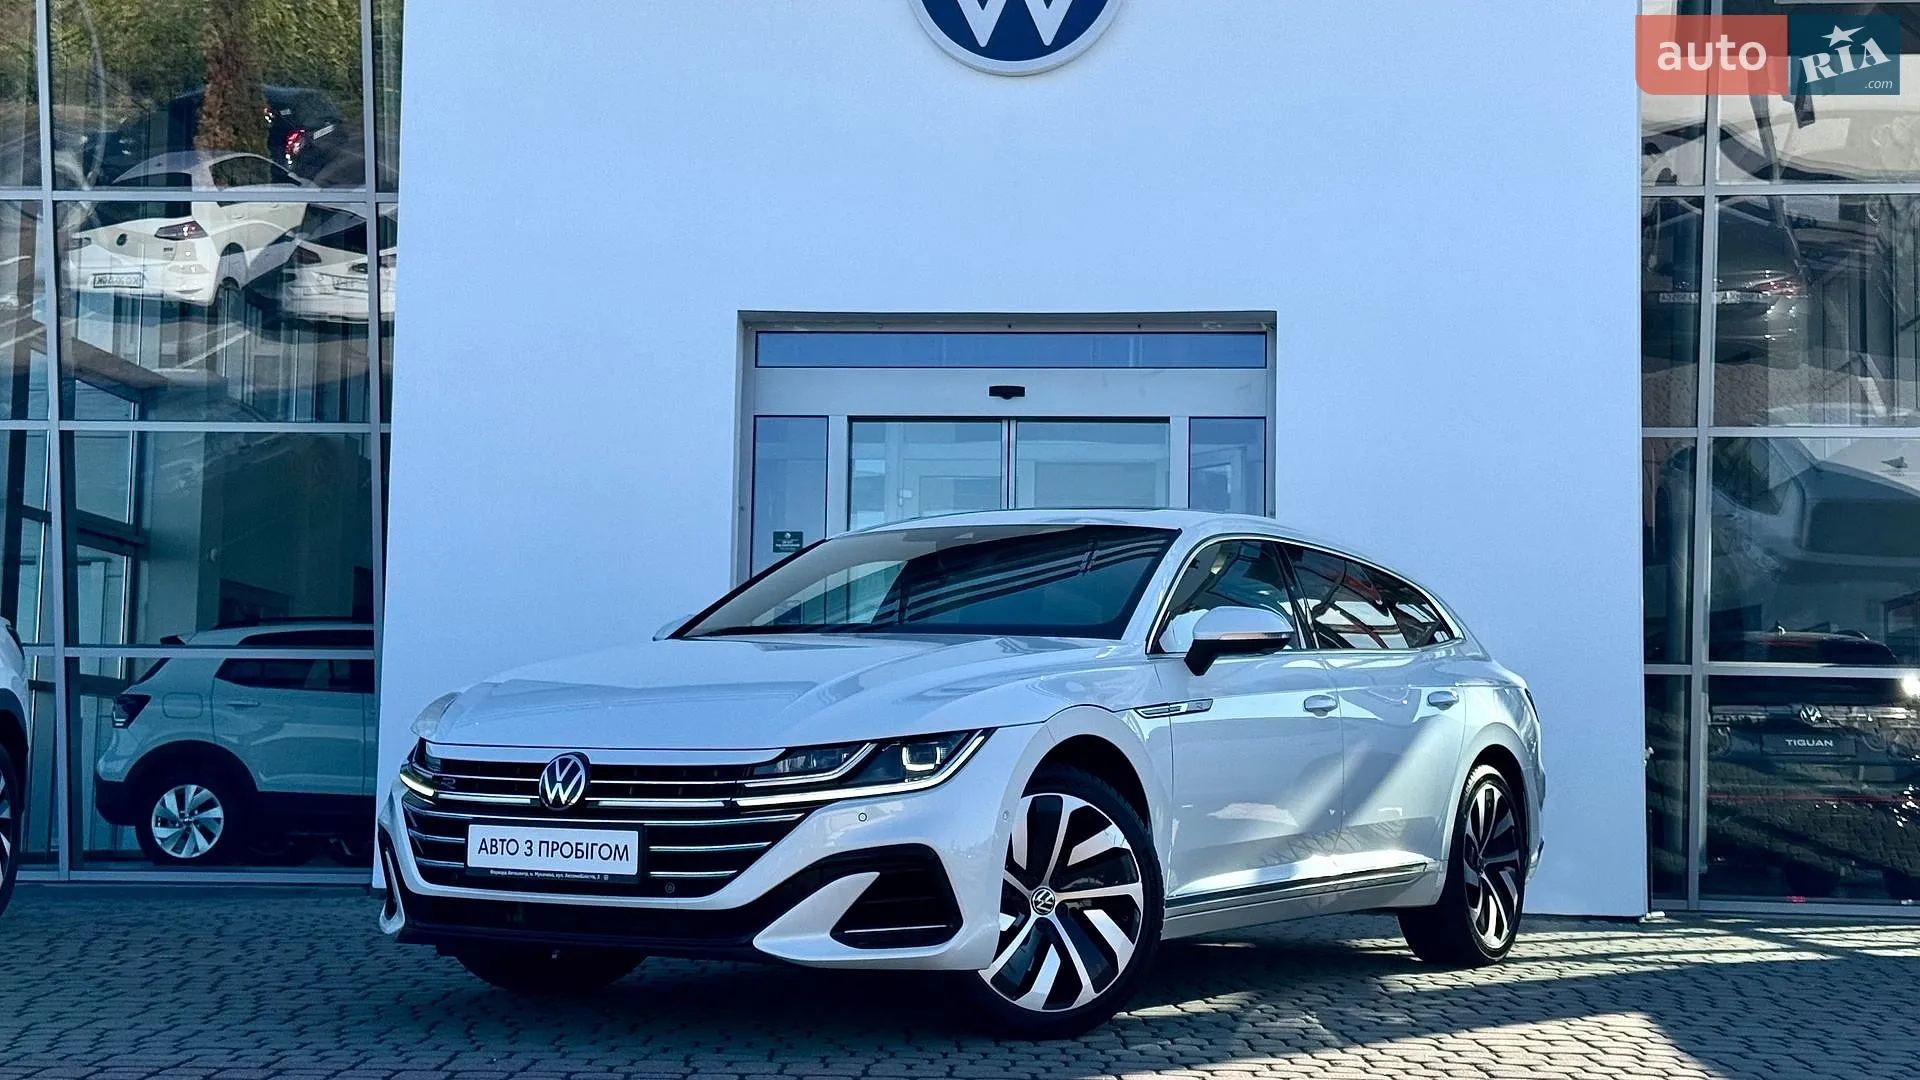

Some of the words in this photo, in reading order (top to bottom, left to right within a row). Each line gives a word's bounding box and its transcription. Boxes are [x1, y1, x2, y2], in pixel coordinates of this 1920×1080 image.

[1785, 739, 1833, 747] TIGUAN
[478, 837, 519, 856] АВТО
[538, 841, 630, 862] ПРОБІГОМ
